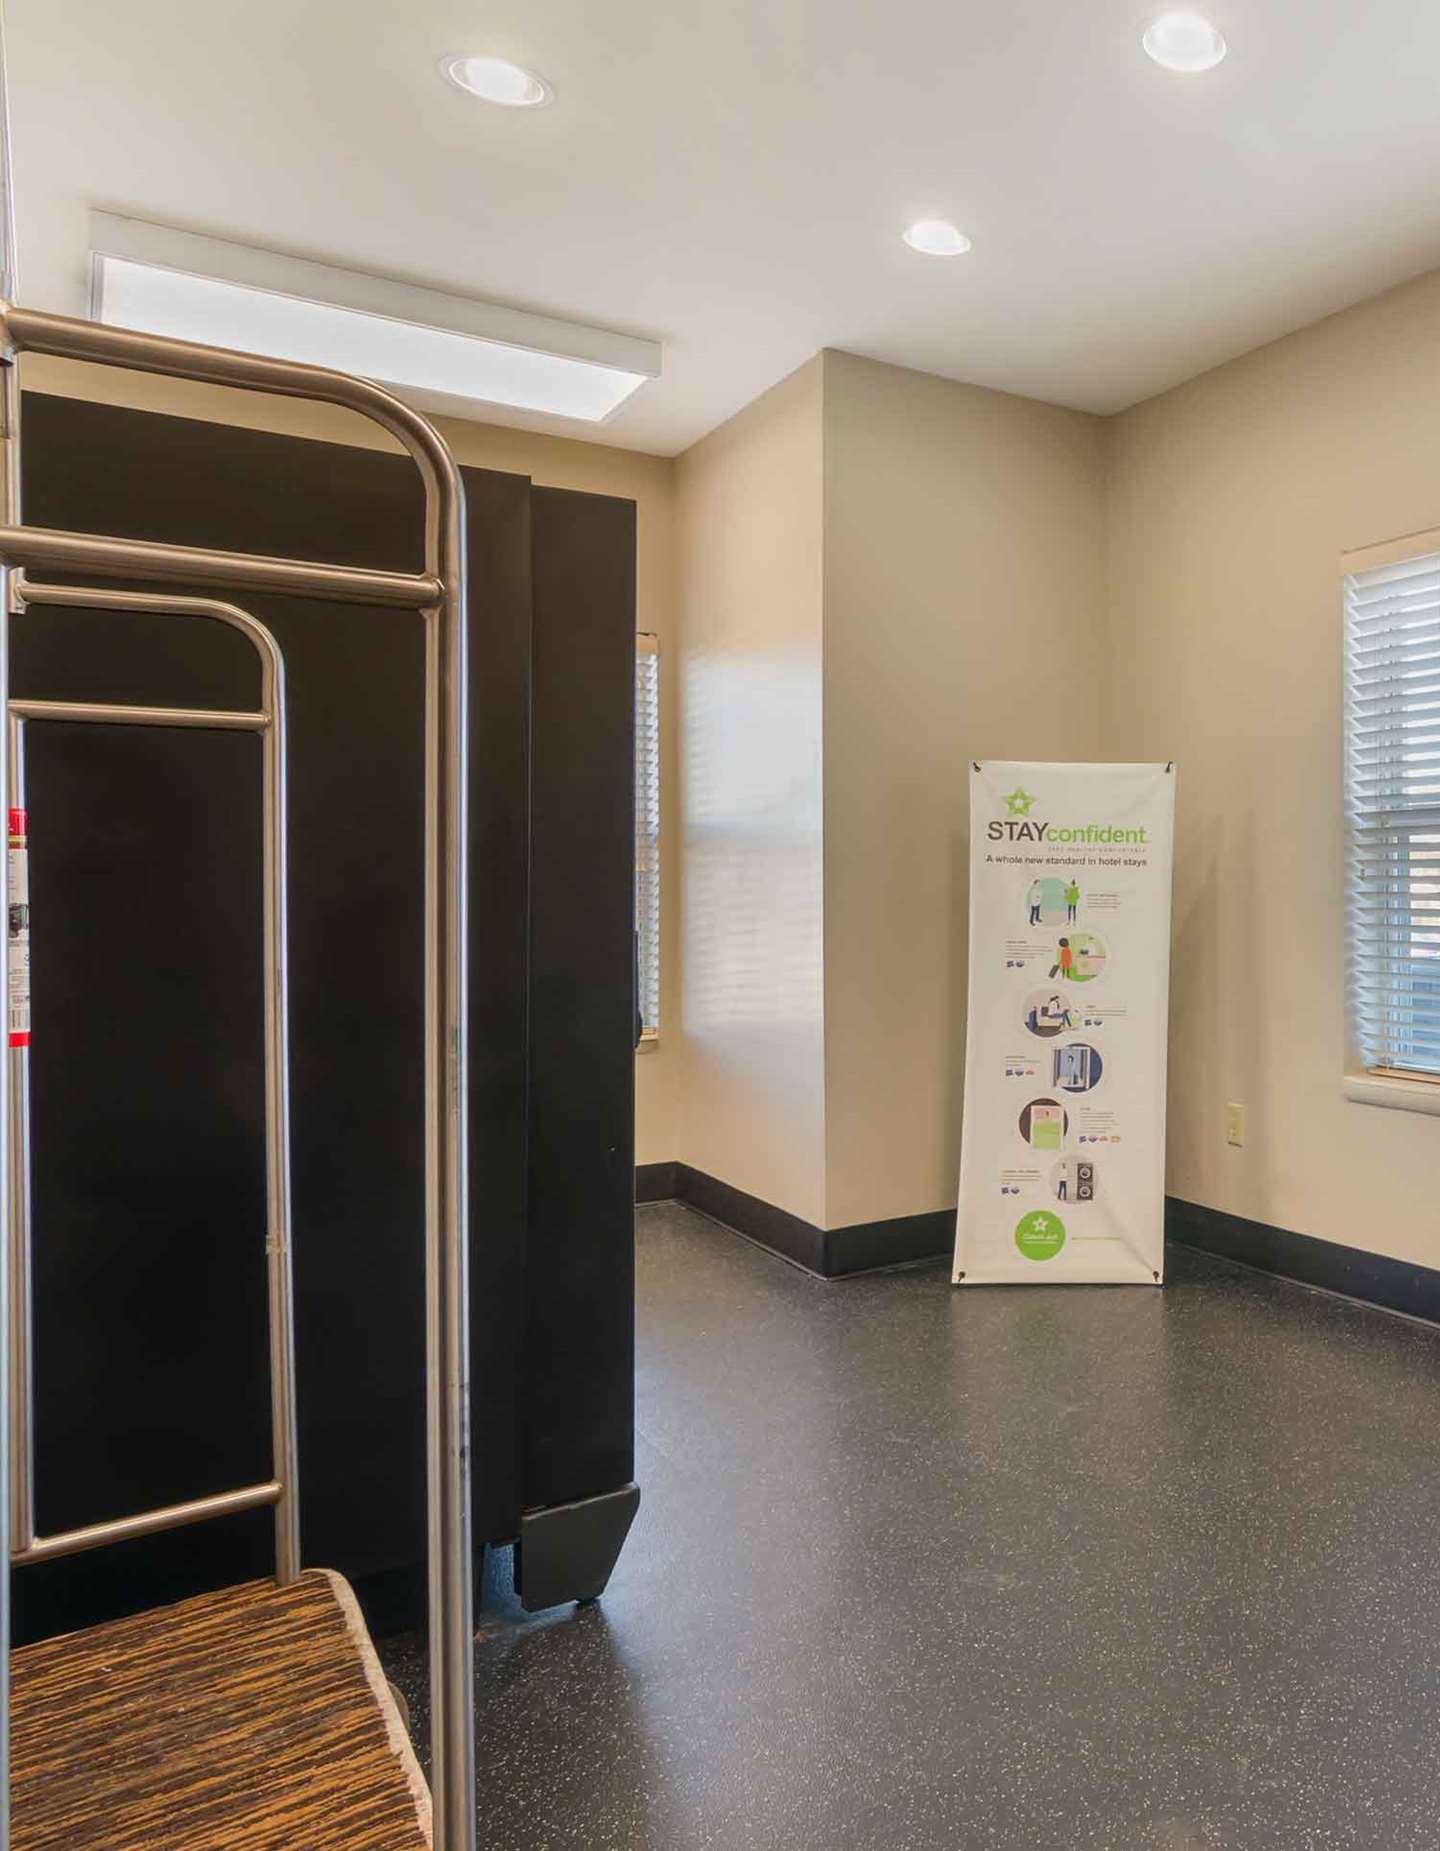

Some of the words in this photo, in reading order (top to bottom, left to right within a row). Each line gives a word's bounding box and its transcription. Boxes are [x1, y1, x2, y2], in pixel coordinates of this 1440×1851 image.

[986, 855, 994, 863] A
[996, 856, 1023, 864] whole
[1045, 856, 1086, 865] standard
[1088, 857, 1096, 865] in
[1099, 856, 1121, 866] hotel
[1123, 858, 1147, 867] stays
